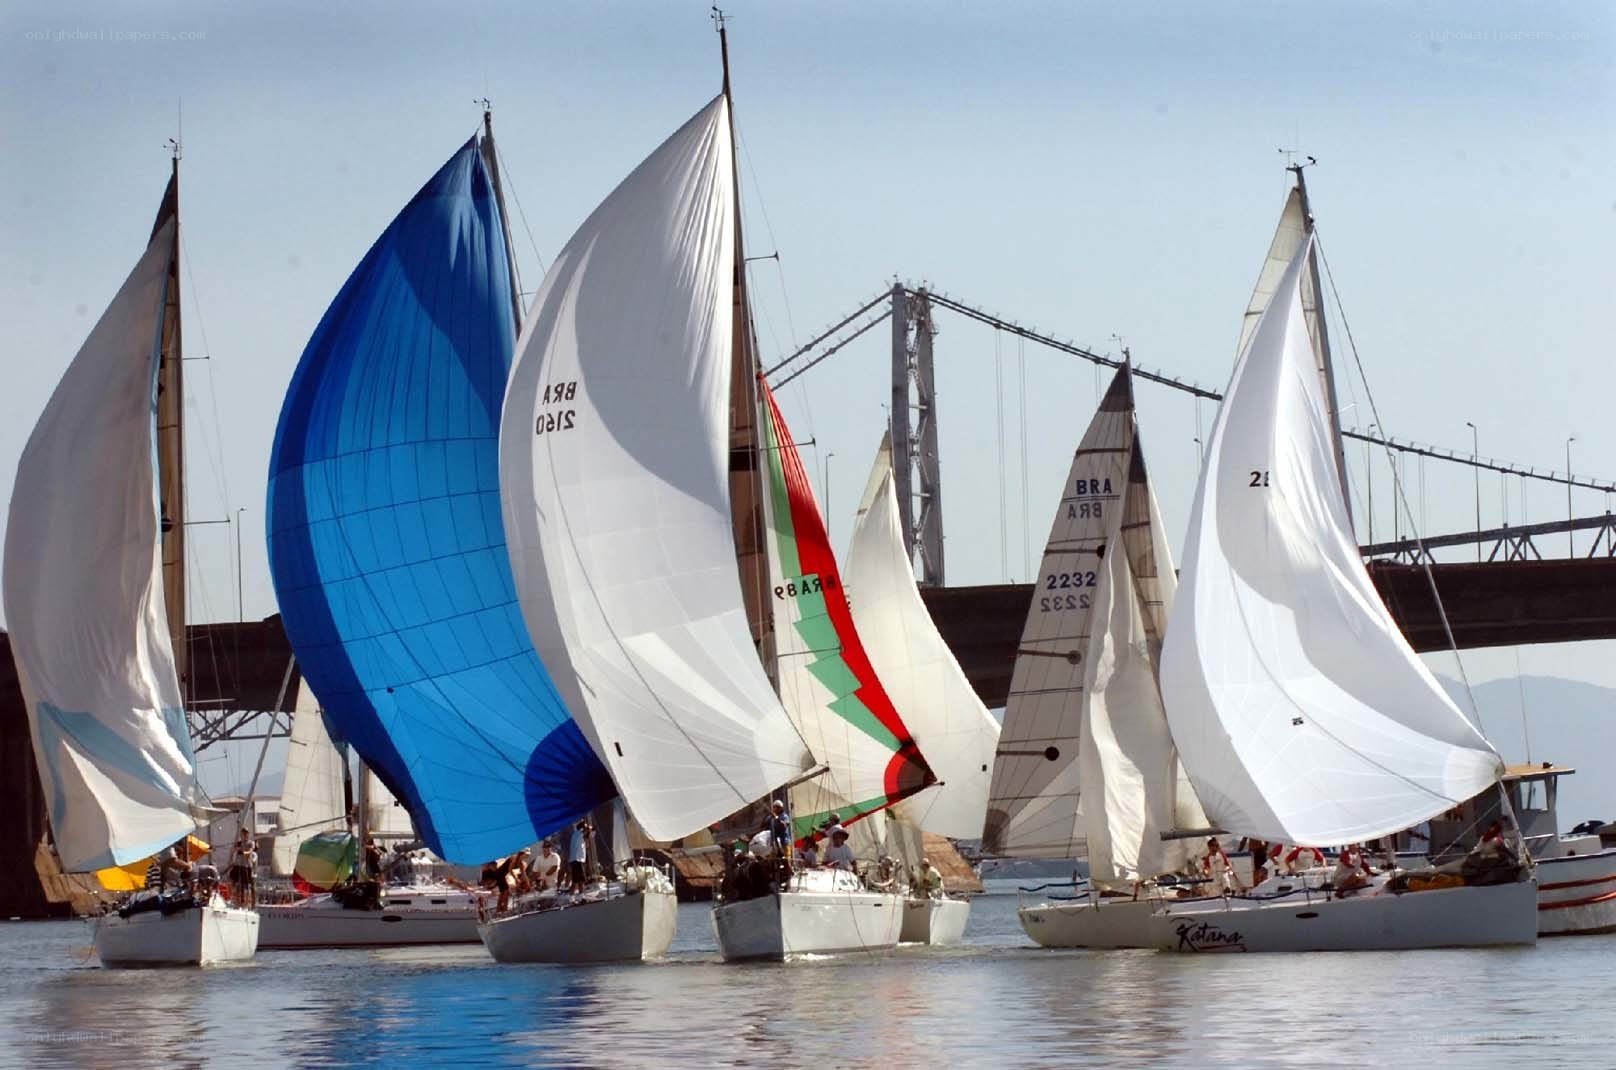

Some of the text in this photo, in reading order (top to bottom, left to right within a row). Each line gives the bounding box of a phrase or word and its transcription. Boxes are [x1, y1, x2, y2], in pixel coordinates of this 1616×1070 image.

[1076, 478, 1112, 495] BRA
[1046, 571, 1097, 590] 2232
[1172, 917, 1246, 953] Katana
